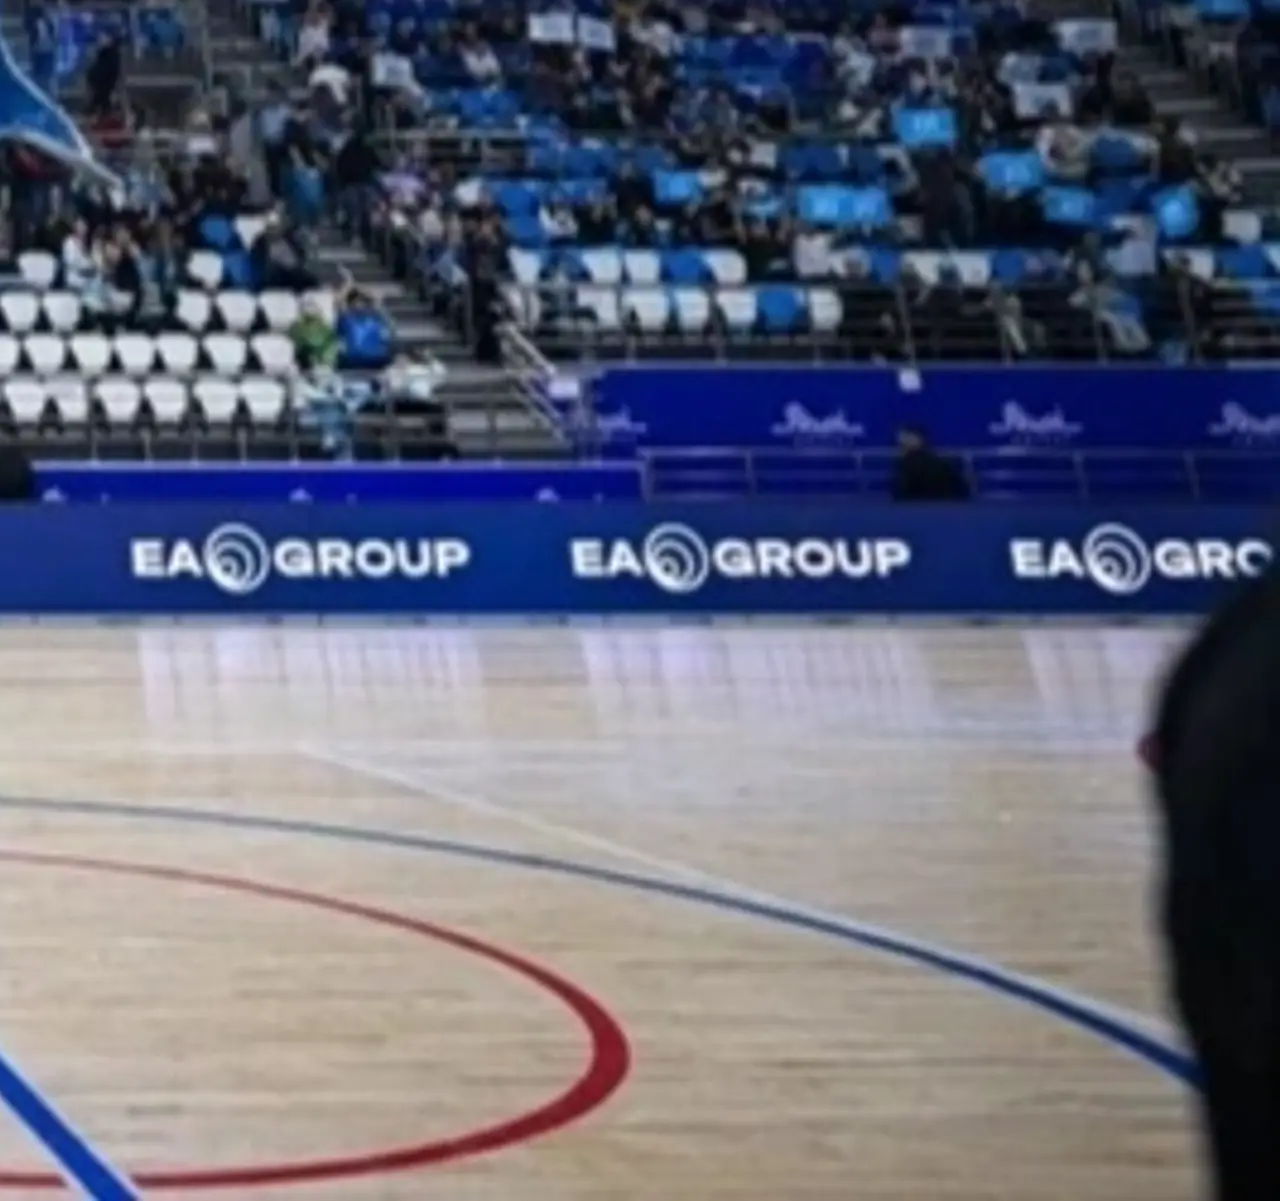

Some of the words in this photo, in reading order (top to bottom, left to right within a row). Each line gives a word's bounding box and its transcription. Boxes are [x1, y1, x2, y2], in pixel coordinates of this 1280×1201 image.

[130, 539, 204, 577] EA
[272, 539, 470, 577] GROUP
[571, 539, 643, 577] EA
[711, 539, 911, 577] GROUP
[1009, 539, 1085, 577] EA
[1153, 538, 1273, 579] GRO
